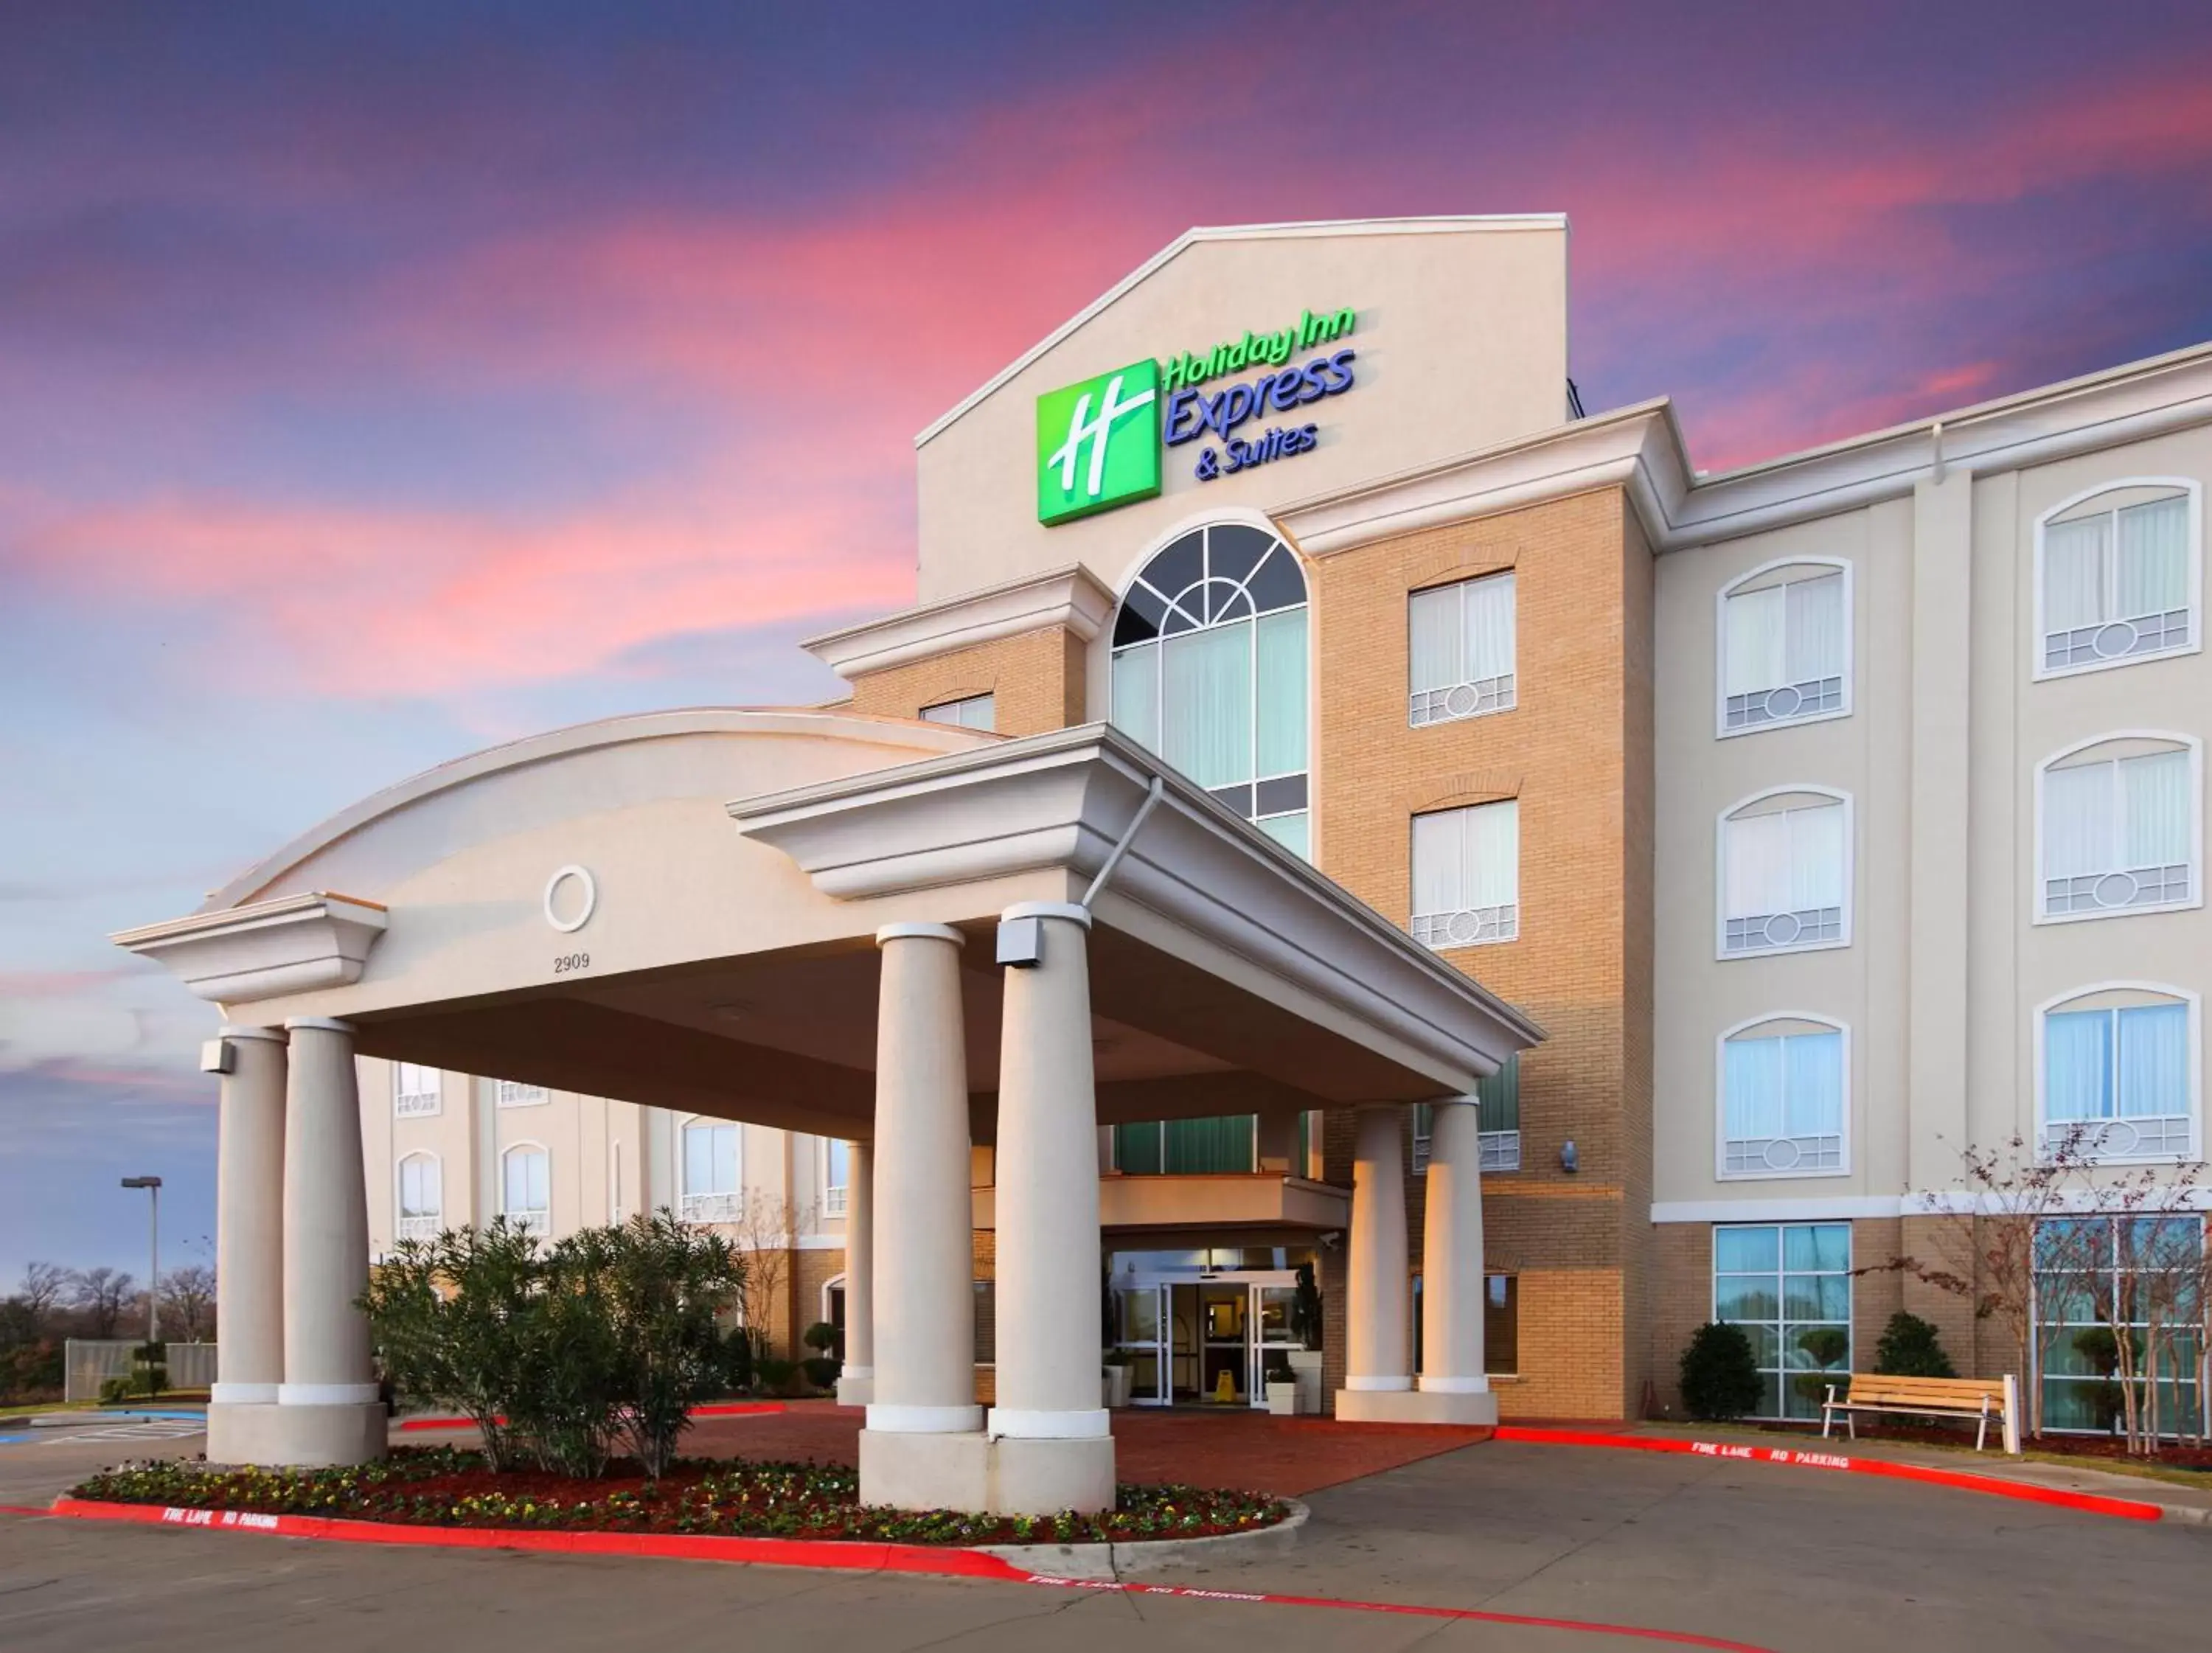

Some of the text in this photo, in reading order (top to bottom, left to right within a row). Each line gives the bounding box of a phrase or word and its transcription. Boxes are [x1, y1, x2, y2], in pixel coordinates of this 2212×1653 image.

[1163, 307, 1355, 393] Holiday Inn
[1164, 349, 1356, 448] Express
[1194, 422, 1318, 481] & Suites
[554, 953, 590, 973] 2909
[1691, 1441, 1849, 1469] FIRE LANE NO PARKING
